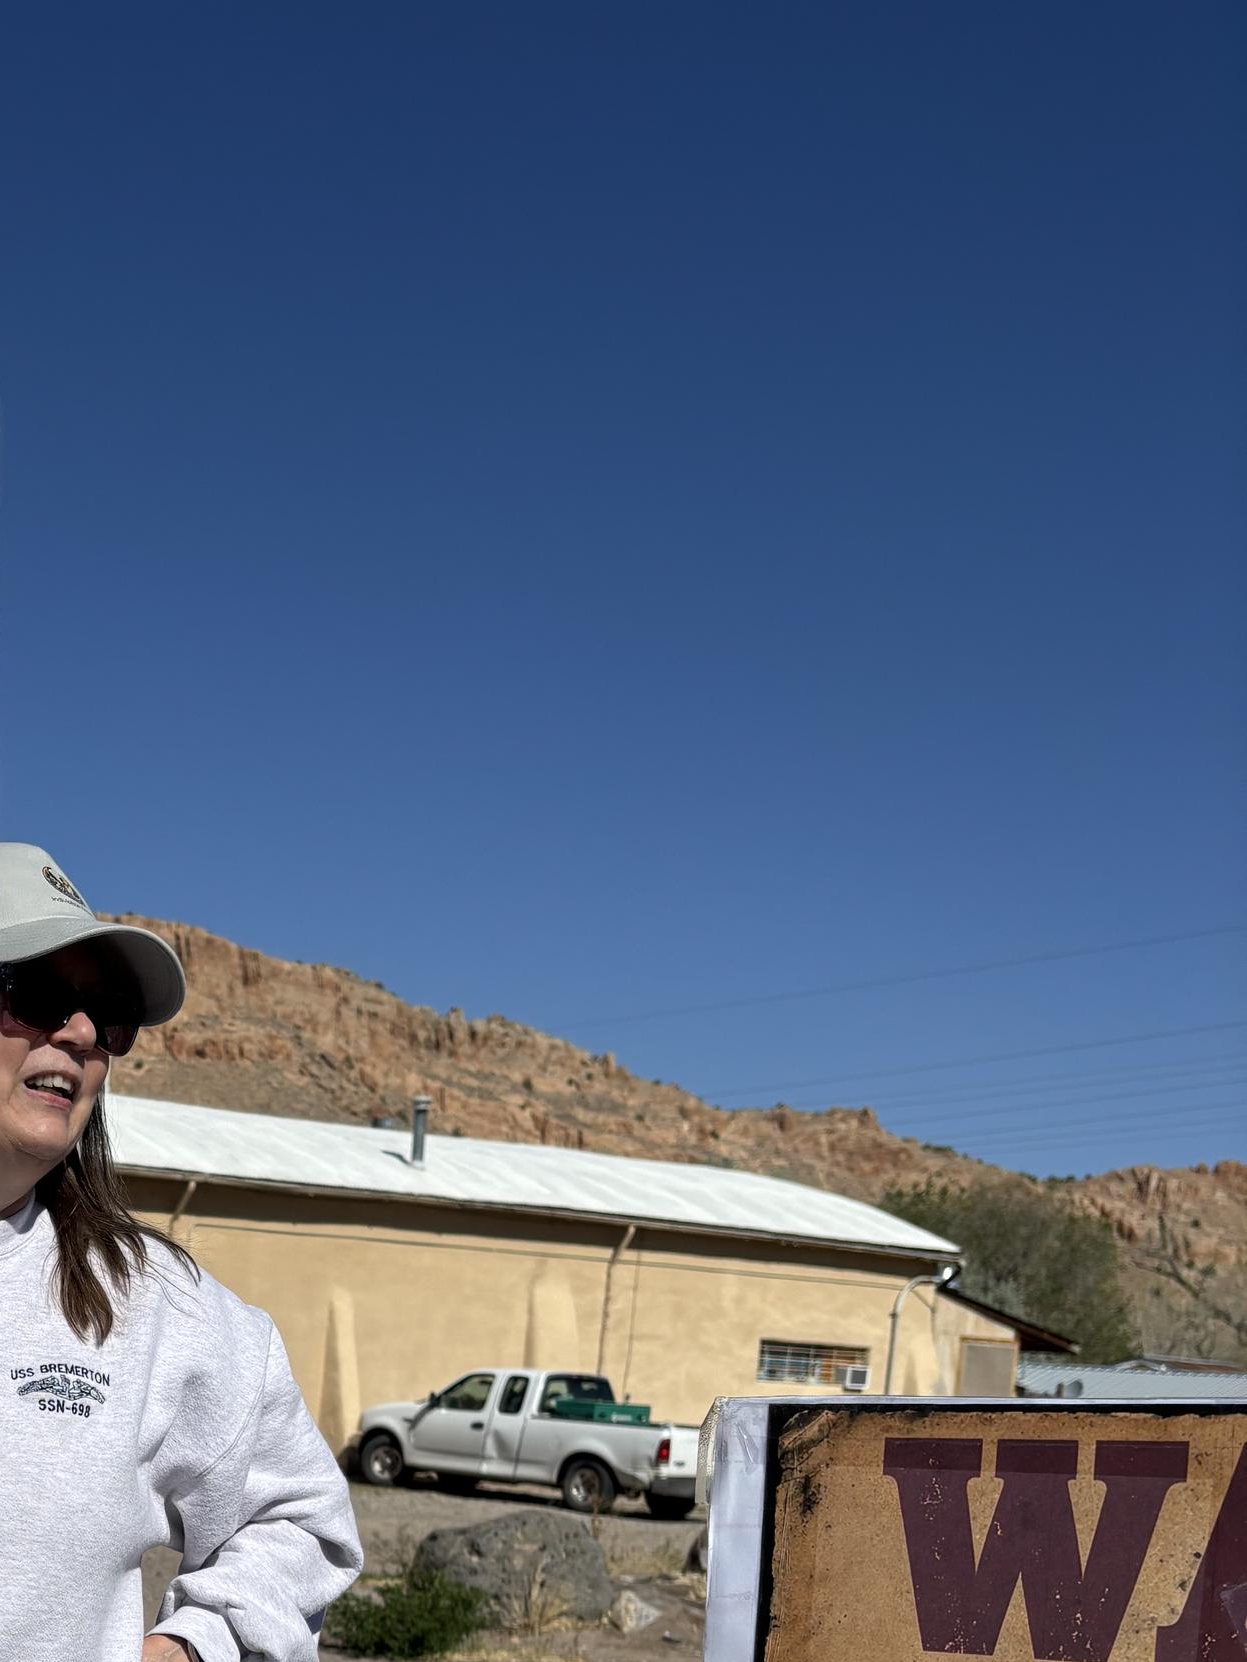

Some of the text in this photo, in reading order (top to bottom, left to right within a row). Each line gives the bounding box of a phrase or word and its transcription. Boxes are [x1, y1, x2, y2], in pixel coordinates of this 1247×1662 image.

[10, 1363, 110, 1386] USS BREMERTON
[38, 1399, 91, 1418] SSN-698
